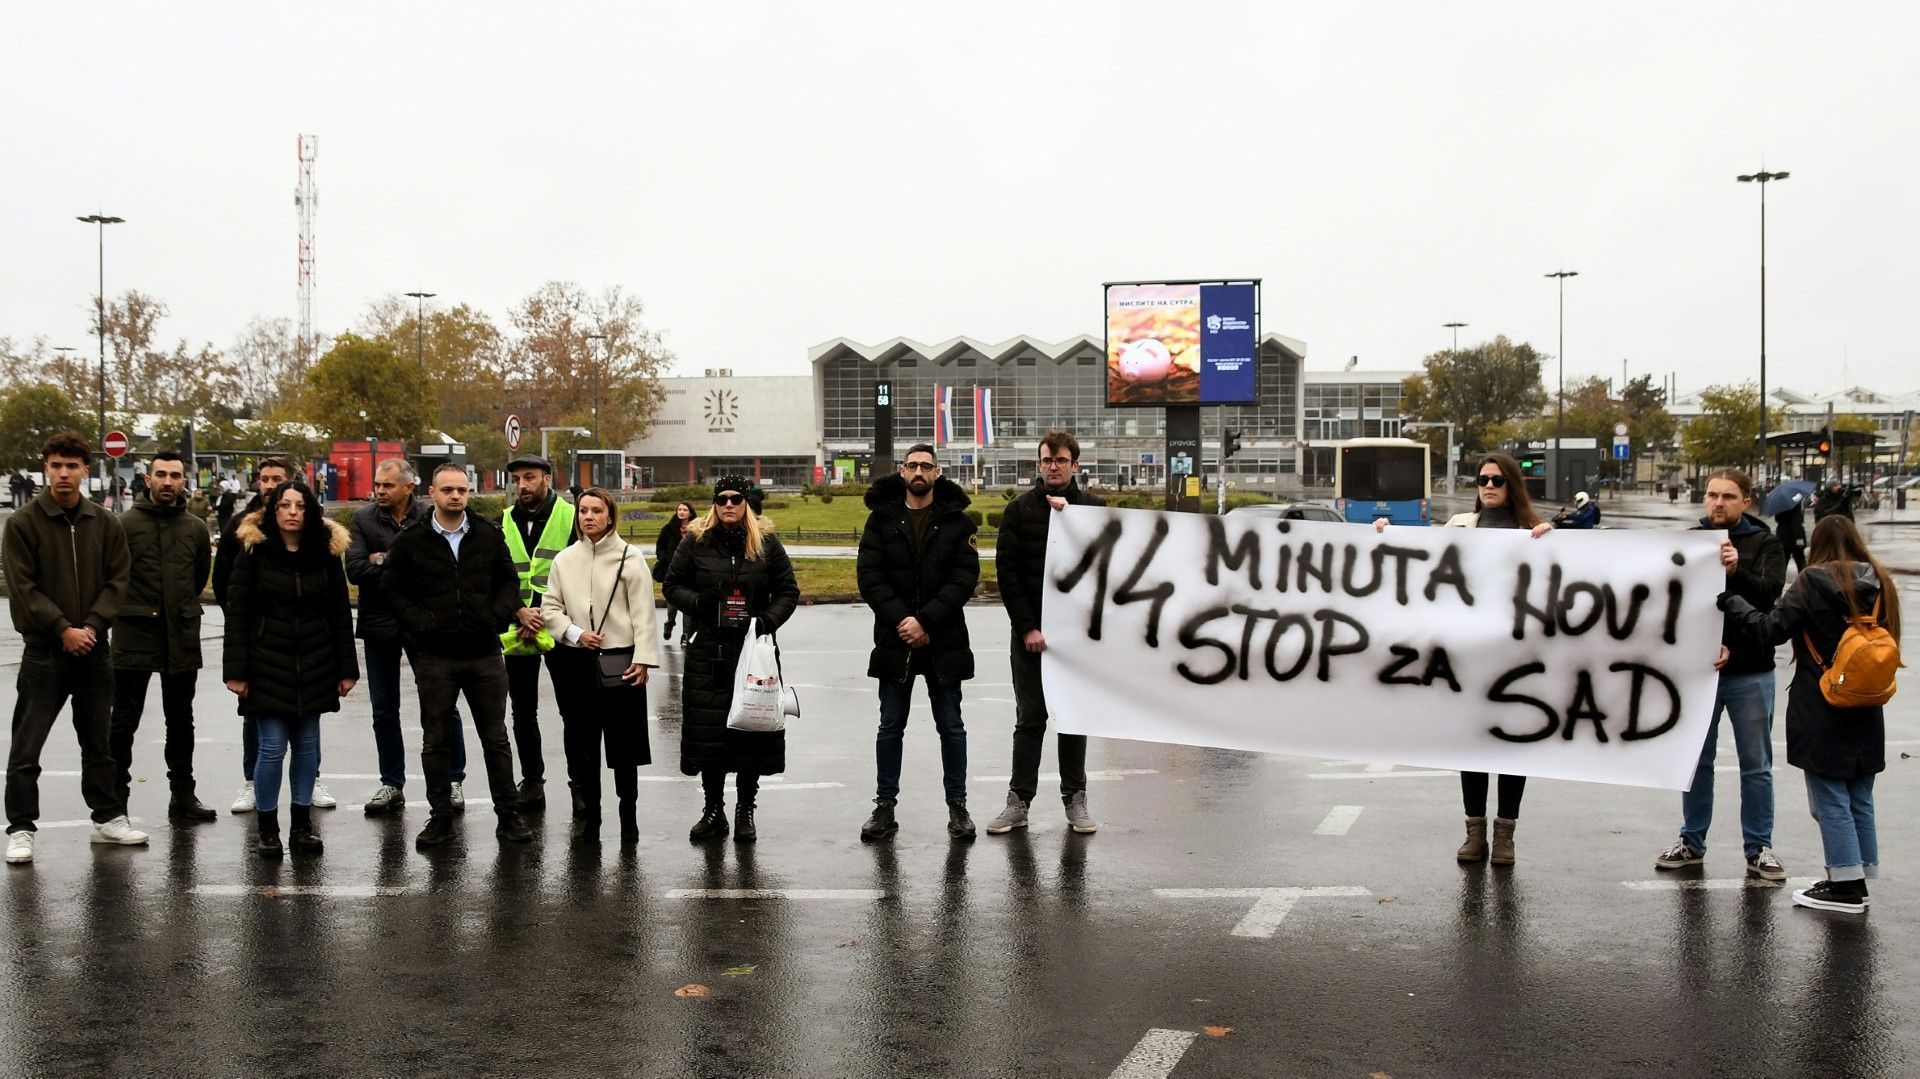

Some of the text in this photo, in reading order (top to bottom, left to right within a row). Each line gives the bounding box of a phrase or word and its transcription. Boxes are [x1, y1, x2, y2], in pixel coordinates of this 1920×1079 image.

[877, 384, 888, 394] 11
[877, 395, 889, 405] 58
[1055, 517, 1176, 647] 14
[1176, 603, 1370, 685] STOP
[1487, 661, 1682, 743] SAD
